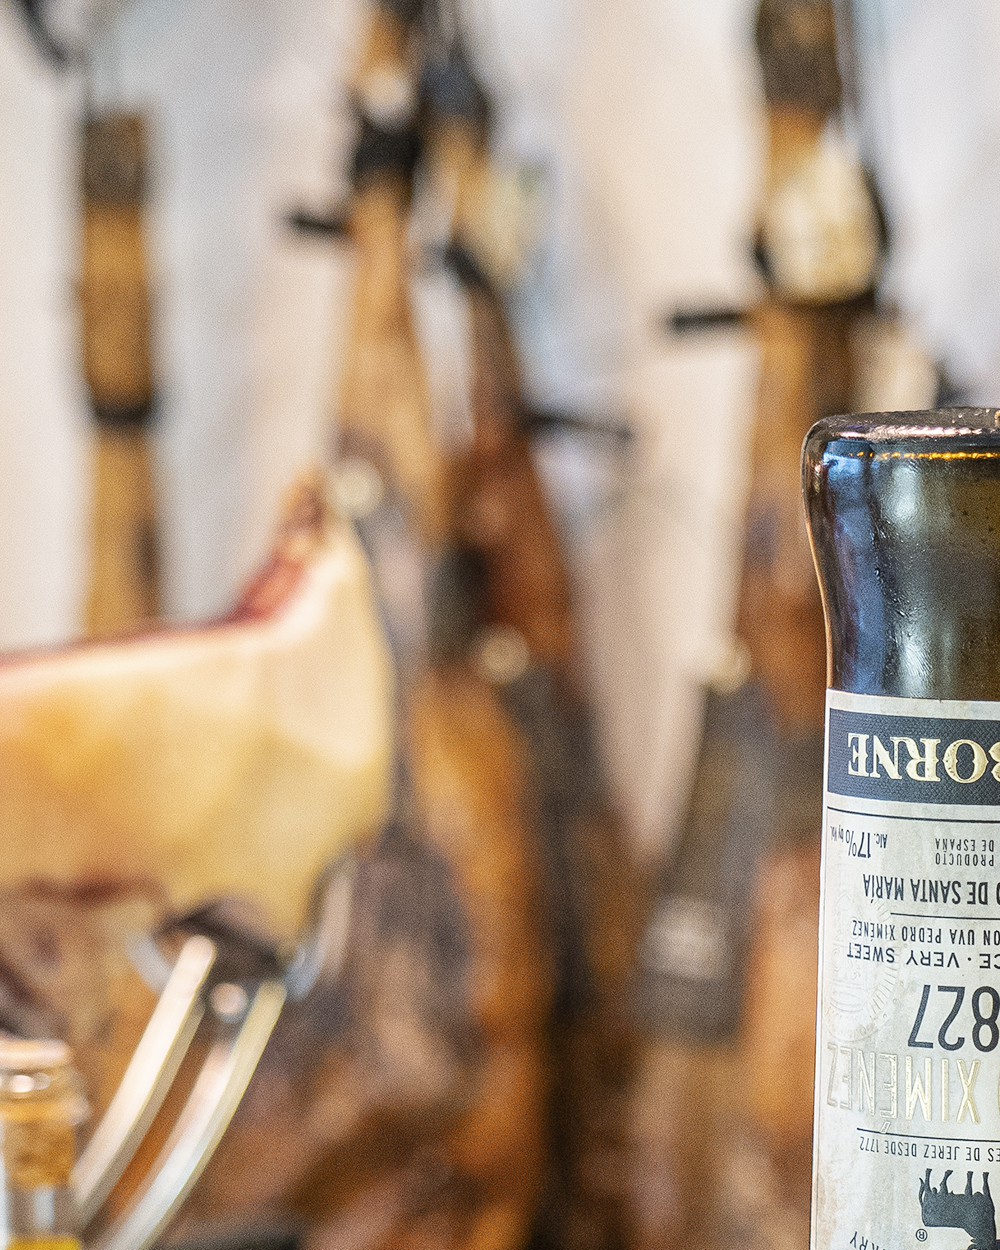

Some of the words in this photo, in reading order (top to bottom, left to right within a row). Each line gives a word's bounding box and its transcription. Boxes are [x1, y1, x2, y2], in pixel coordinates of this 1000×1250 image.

[846, 829, 872, 858] 17%
[874, 834, 887, 848] Alc.
[935, 838, 976, 852] ESPAÑA
[982, 840, 994, 851] DE
[935, 853, 994, 866] PRODUCTO
[863, 873, 904, 904] MARÍA
[910, 879, 961, 905] SANTA
[967, 881, 986, 905] DE
[852, 920, 894, 943] XIMÉNEZ
[902, 928, 941, 944] PEDRO
[950, 930, 975, 944] UVA
[847, 943, 895, 963] SWEET
[906, 951, 960, 968] VERY
[827, 1044, 981, 1134] XIMÉNEZ
[859, 1136, 880, 1153] 1772
[884, 1140, 917, 1158] DESDE
[924, 1144, 960, 1160] JEREZ
[966, 1147, 980, 1161] DE
